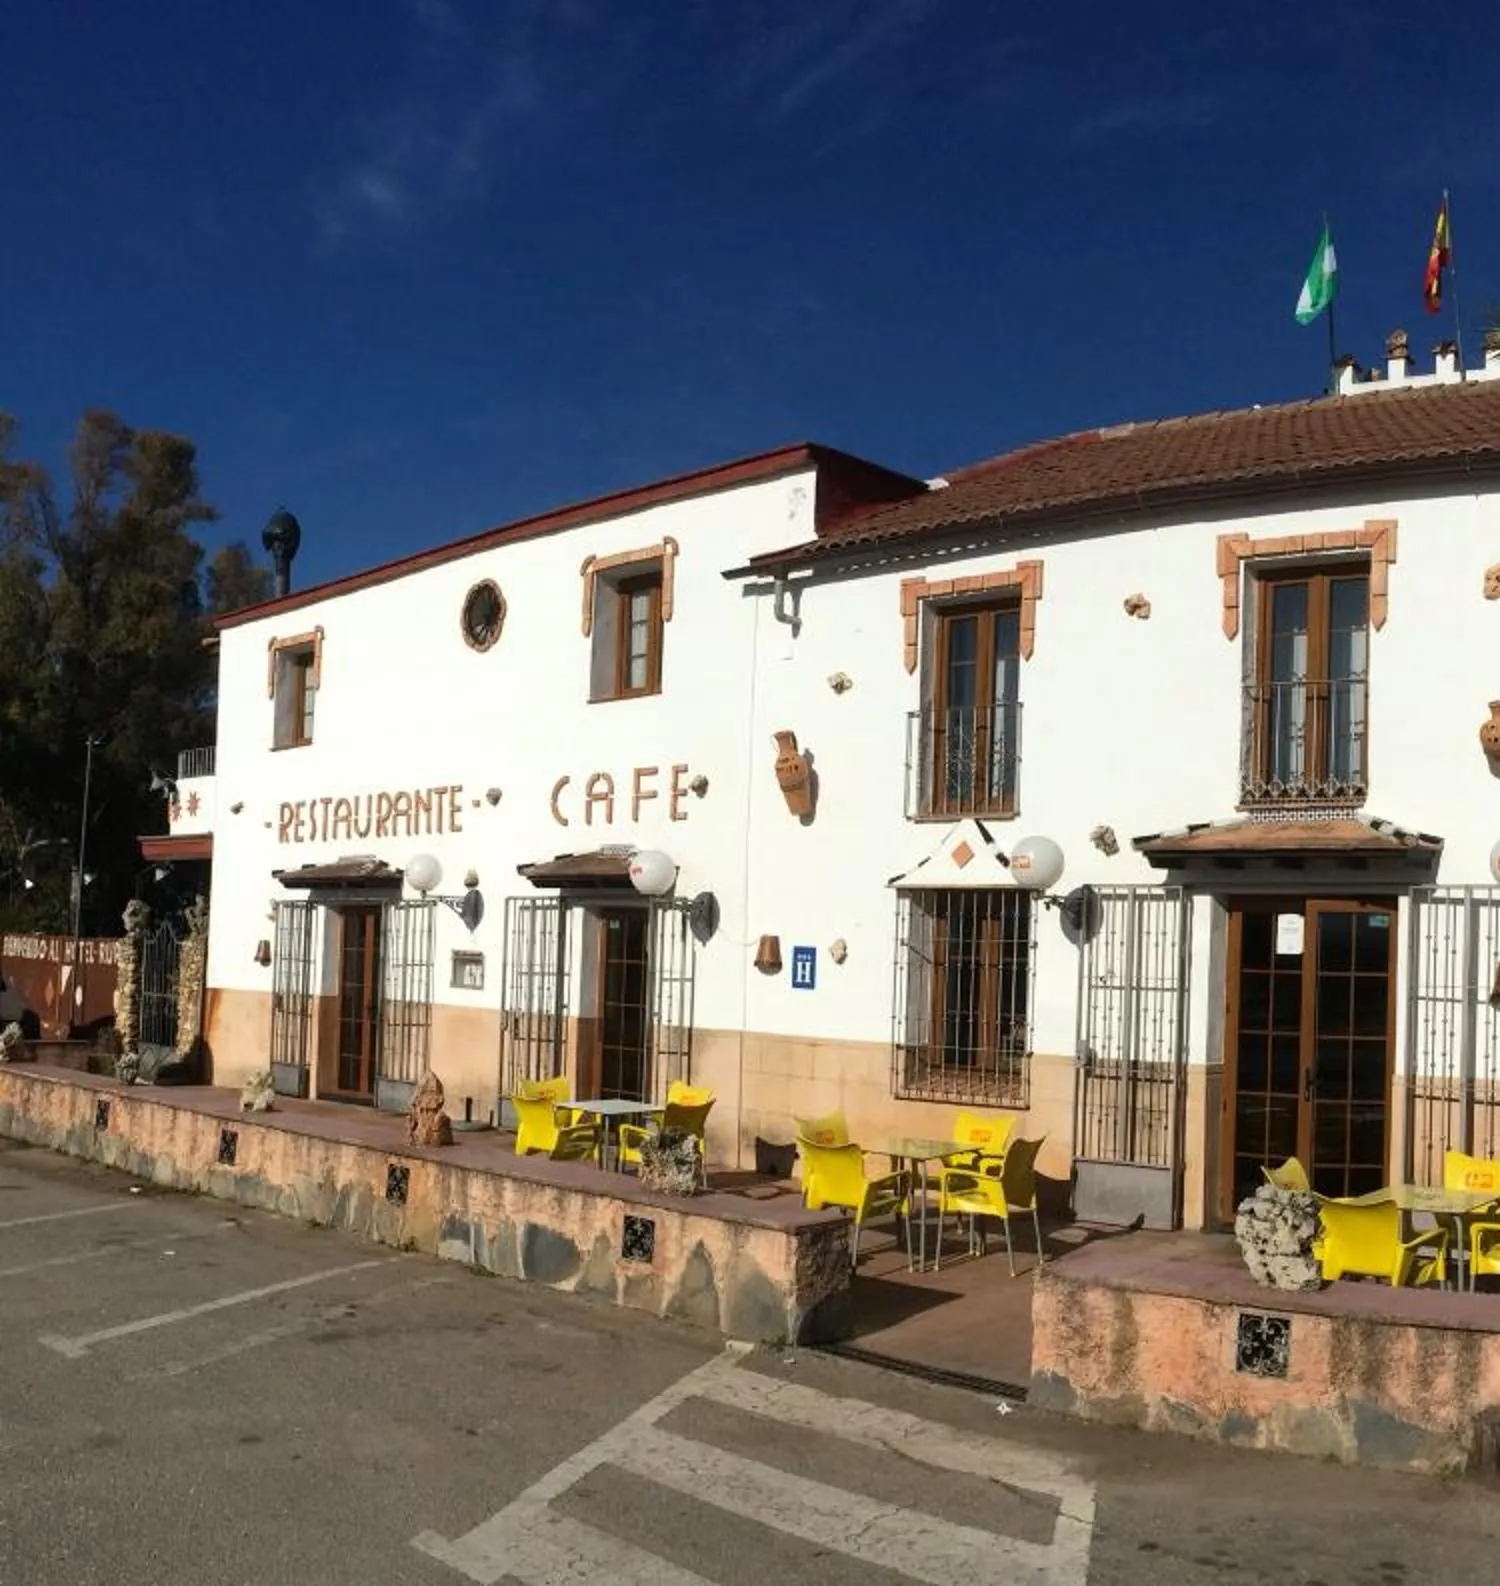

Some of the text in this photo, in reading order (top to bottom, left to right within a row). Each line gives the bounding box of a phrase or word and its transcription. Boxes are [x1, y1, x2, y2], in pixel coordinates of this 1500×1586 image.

[278, 784, 464, 844] RESTAURANTE
[550, 763, 689, 827] CAFE
[796, 961, 812, 983] H
